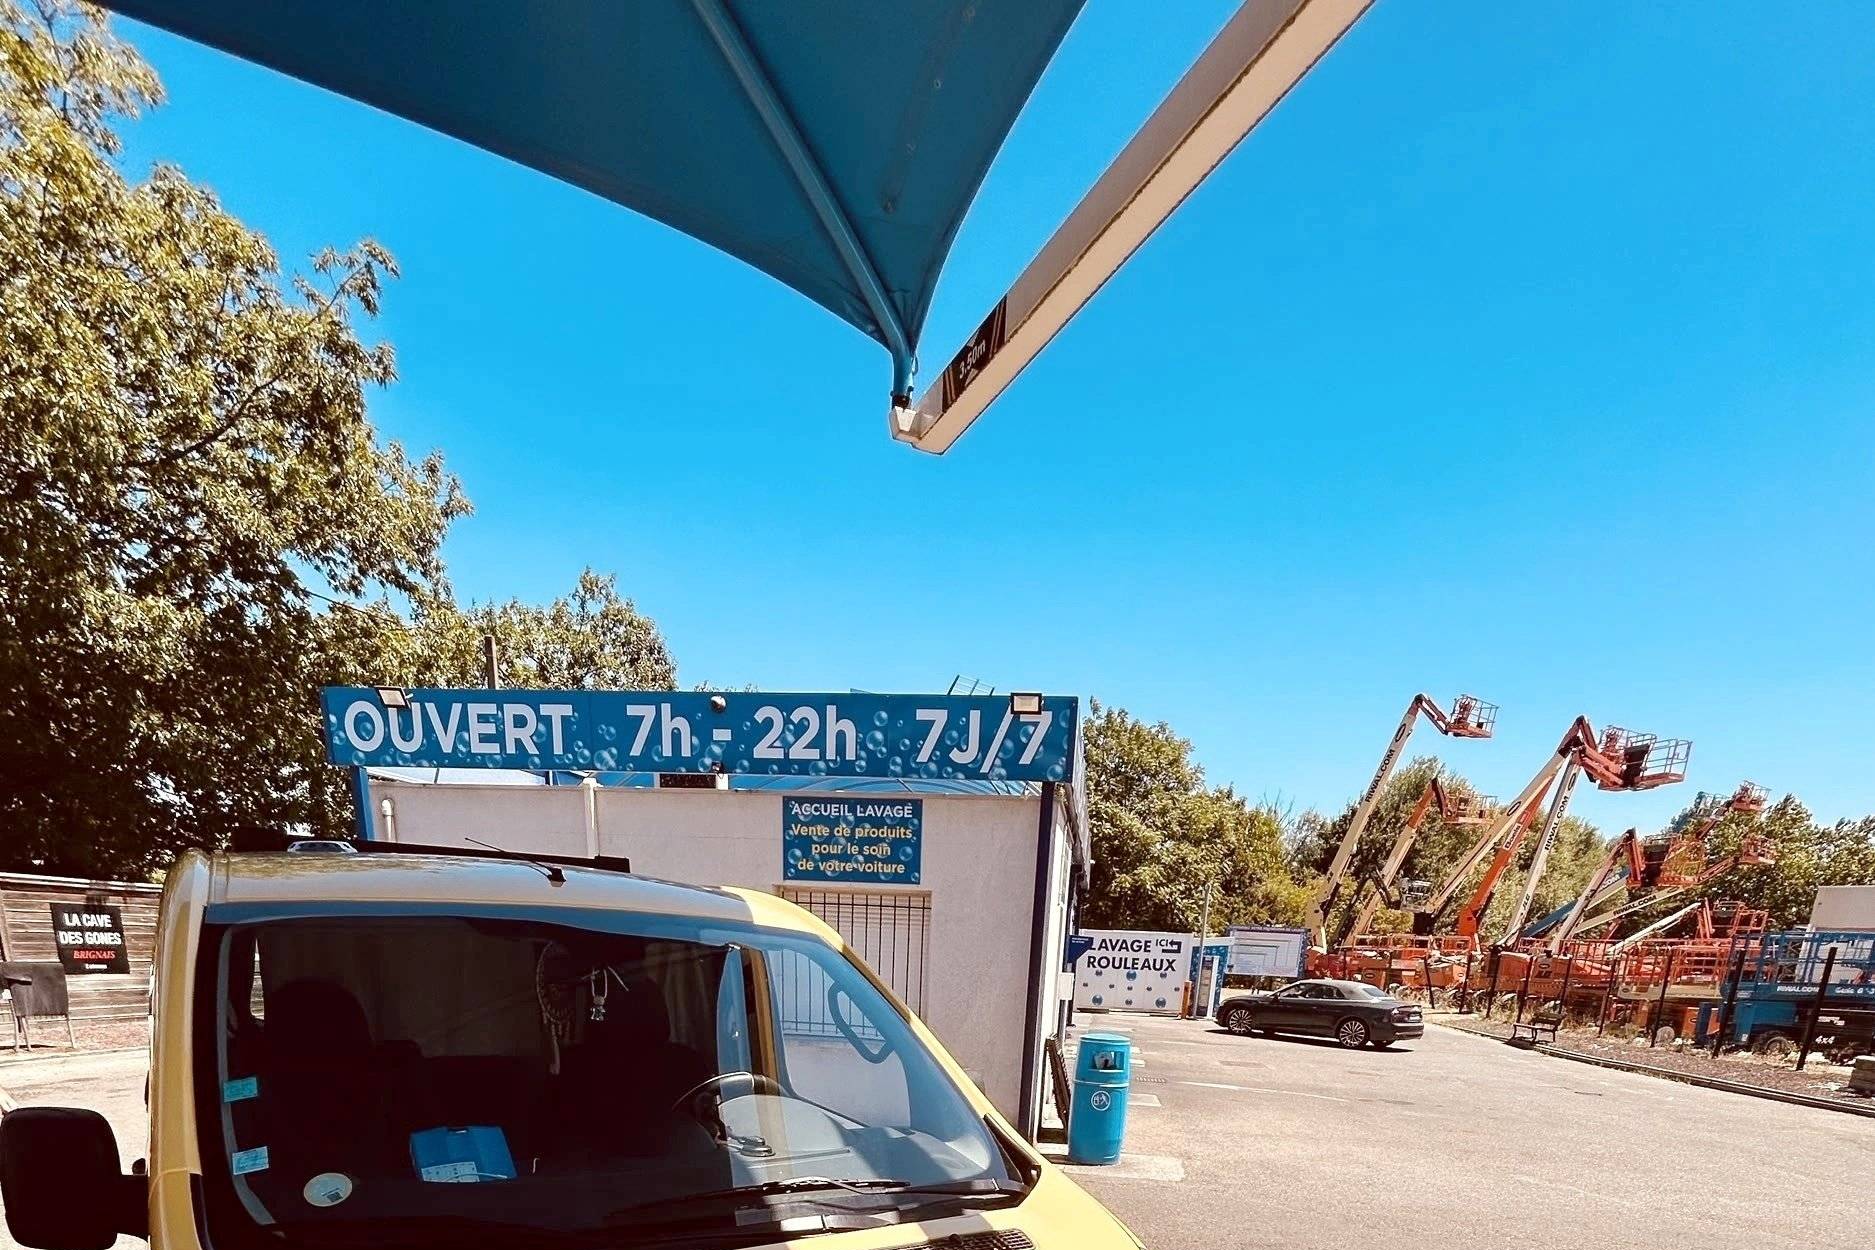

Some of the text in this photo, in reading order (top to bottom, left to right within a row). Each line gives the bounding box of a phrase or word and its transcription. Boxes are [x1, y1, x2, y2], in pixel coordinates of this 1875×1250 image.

[959, 339, 986, 380] 3.50m
[344, 700, 1053, 774] OUVERT 7h - 22h 7J/7
[1365, 748, 1396, 803] RIWAL.COM
[791, 803, 913, 818] ACCUEIL LAVAGE
[1544, 795, 1570, 851] RIWAL.COM
[791, 823, 913, 839] Vente de produits
[811, 843, 891, 855] pour le soin
[797, 858, 905, 873] de votre voiture
[63, 912, 112, 928] LA CAVE
[58, 931, 122, 945] DES GONES
[1155, 938, 1168, 947] ICI
[73, 950, 116, 959] BRIGNAIS
[1087, 955, 1177, 972] ROULEAUX
[1815, 1035, 1836, 1044] 4x4
